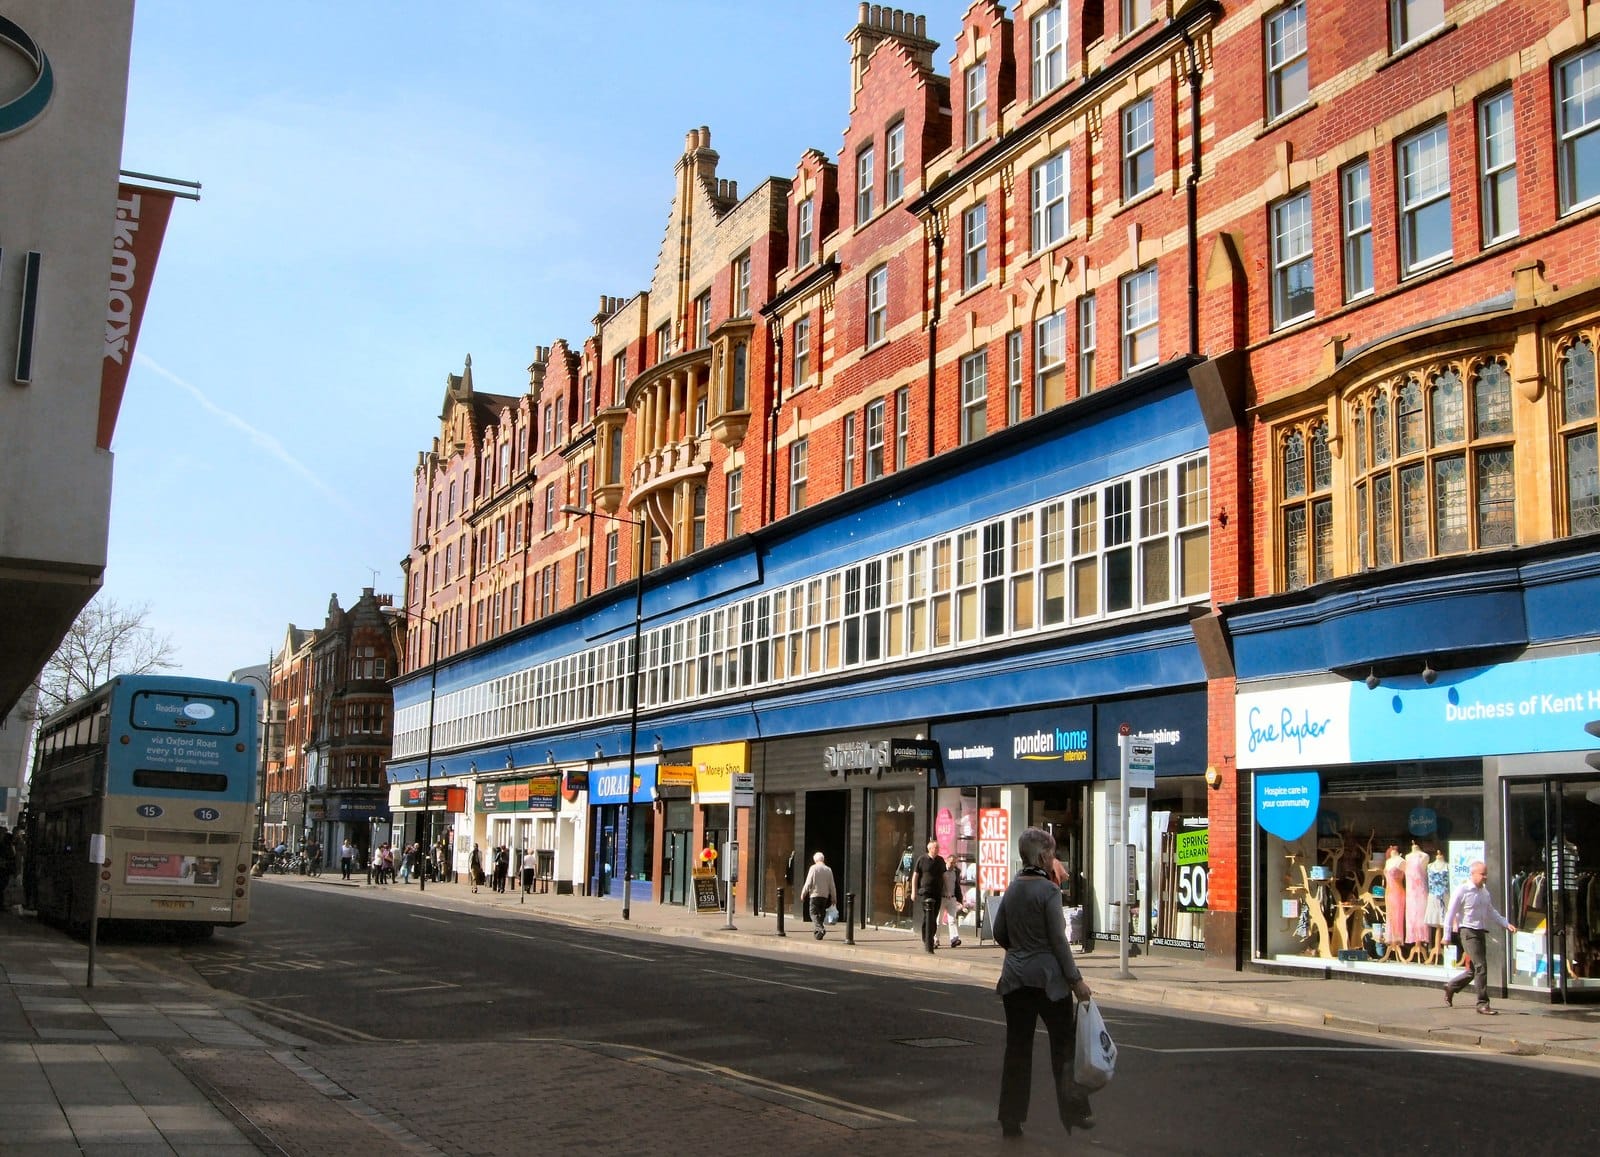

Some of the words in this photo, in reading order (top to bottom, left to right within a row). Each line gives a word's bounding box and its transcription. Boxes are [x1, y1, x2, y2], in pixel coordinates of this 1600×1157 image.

[1445, 700, 1514, 721] Duchess
[1519, 696, 1537, 715] of
[1542, 693, 1583, 714] Kent
[1248, 706, 1279, 752] Sue
[1281, 707, 1331, 754] Ryder
[166, 737, 194, 746] Oxford
[196, 739, 216, 748] Road
[1014, 730, 1054, 759] ponden
[1056, 728, 1087, 751] home
[147, 747, 169, 756] every
[173, 748, 184, 756] 10
[187, 750, 219, 759] minutes
[1064, 750, 1087, 762] interiors
[706, 765, 724, 777] Money
[598, 775, 630, 797] CORAL
[1264, 787, 1287, 796] Hospice
[1301, 786, 1307, 794] in
[1262, 801, 1275, 809] your
[1276, 798, 1309, 808] community
[144, 806, 155, 816] 15
[201, 810, 212, 820] 16
[981, 817, 1006, 840] SALE
[1183, 835, 1208, 848] SPRING
[981, 842, 1005, 864] SALE
[1178, 848, 1208, 860] CLEARAN
[981, 867, 1006, 890] SALE
[1179, 866, 1208, 907] 50
